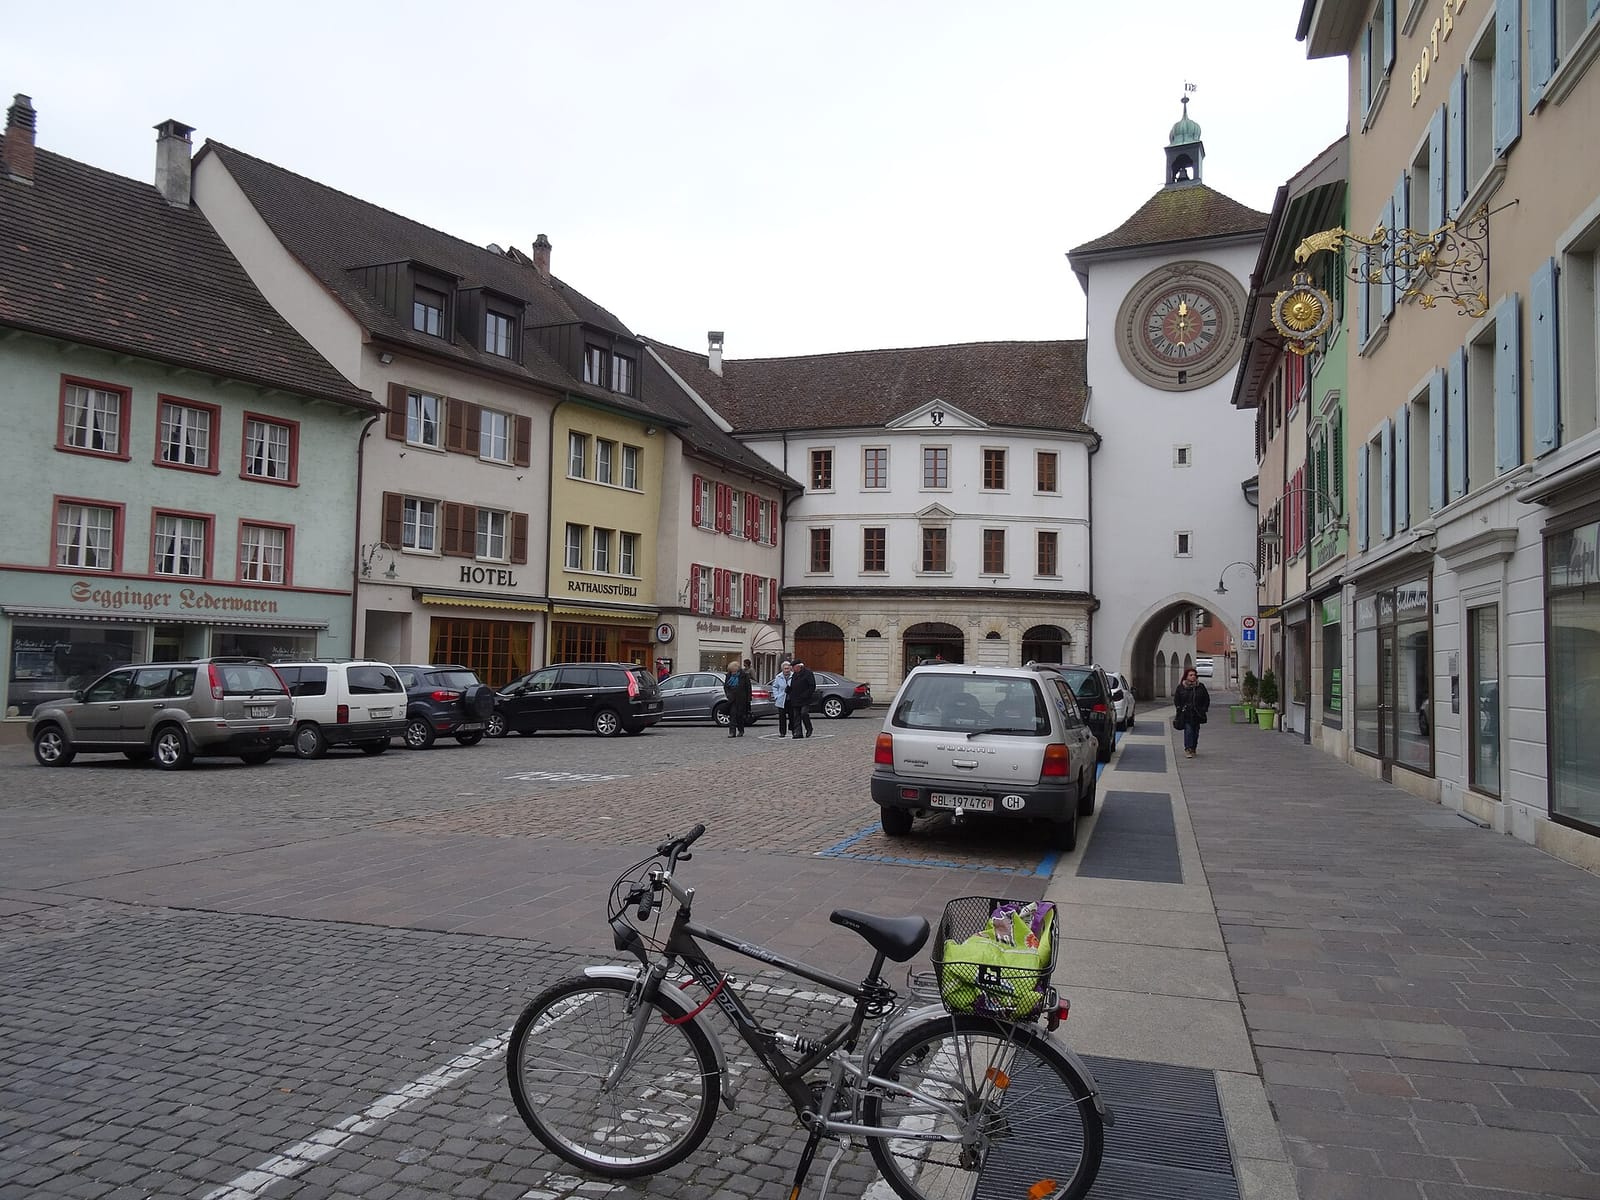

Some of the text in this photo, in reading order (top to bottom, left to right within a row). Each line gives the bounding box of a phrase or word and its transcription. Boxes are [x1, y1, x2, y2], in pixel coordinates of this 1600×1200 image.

[459, 565, 518, 587] HOTEL
[70, 581, 279, 614] Segginger Lederwaren
[567, 580, 637, 597] RATHAUSSTÜBLI
[1006, 797, 1021, 808] CH
